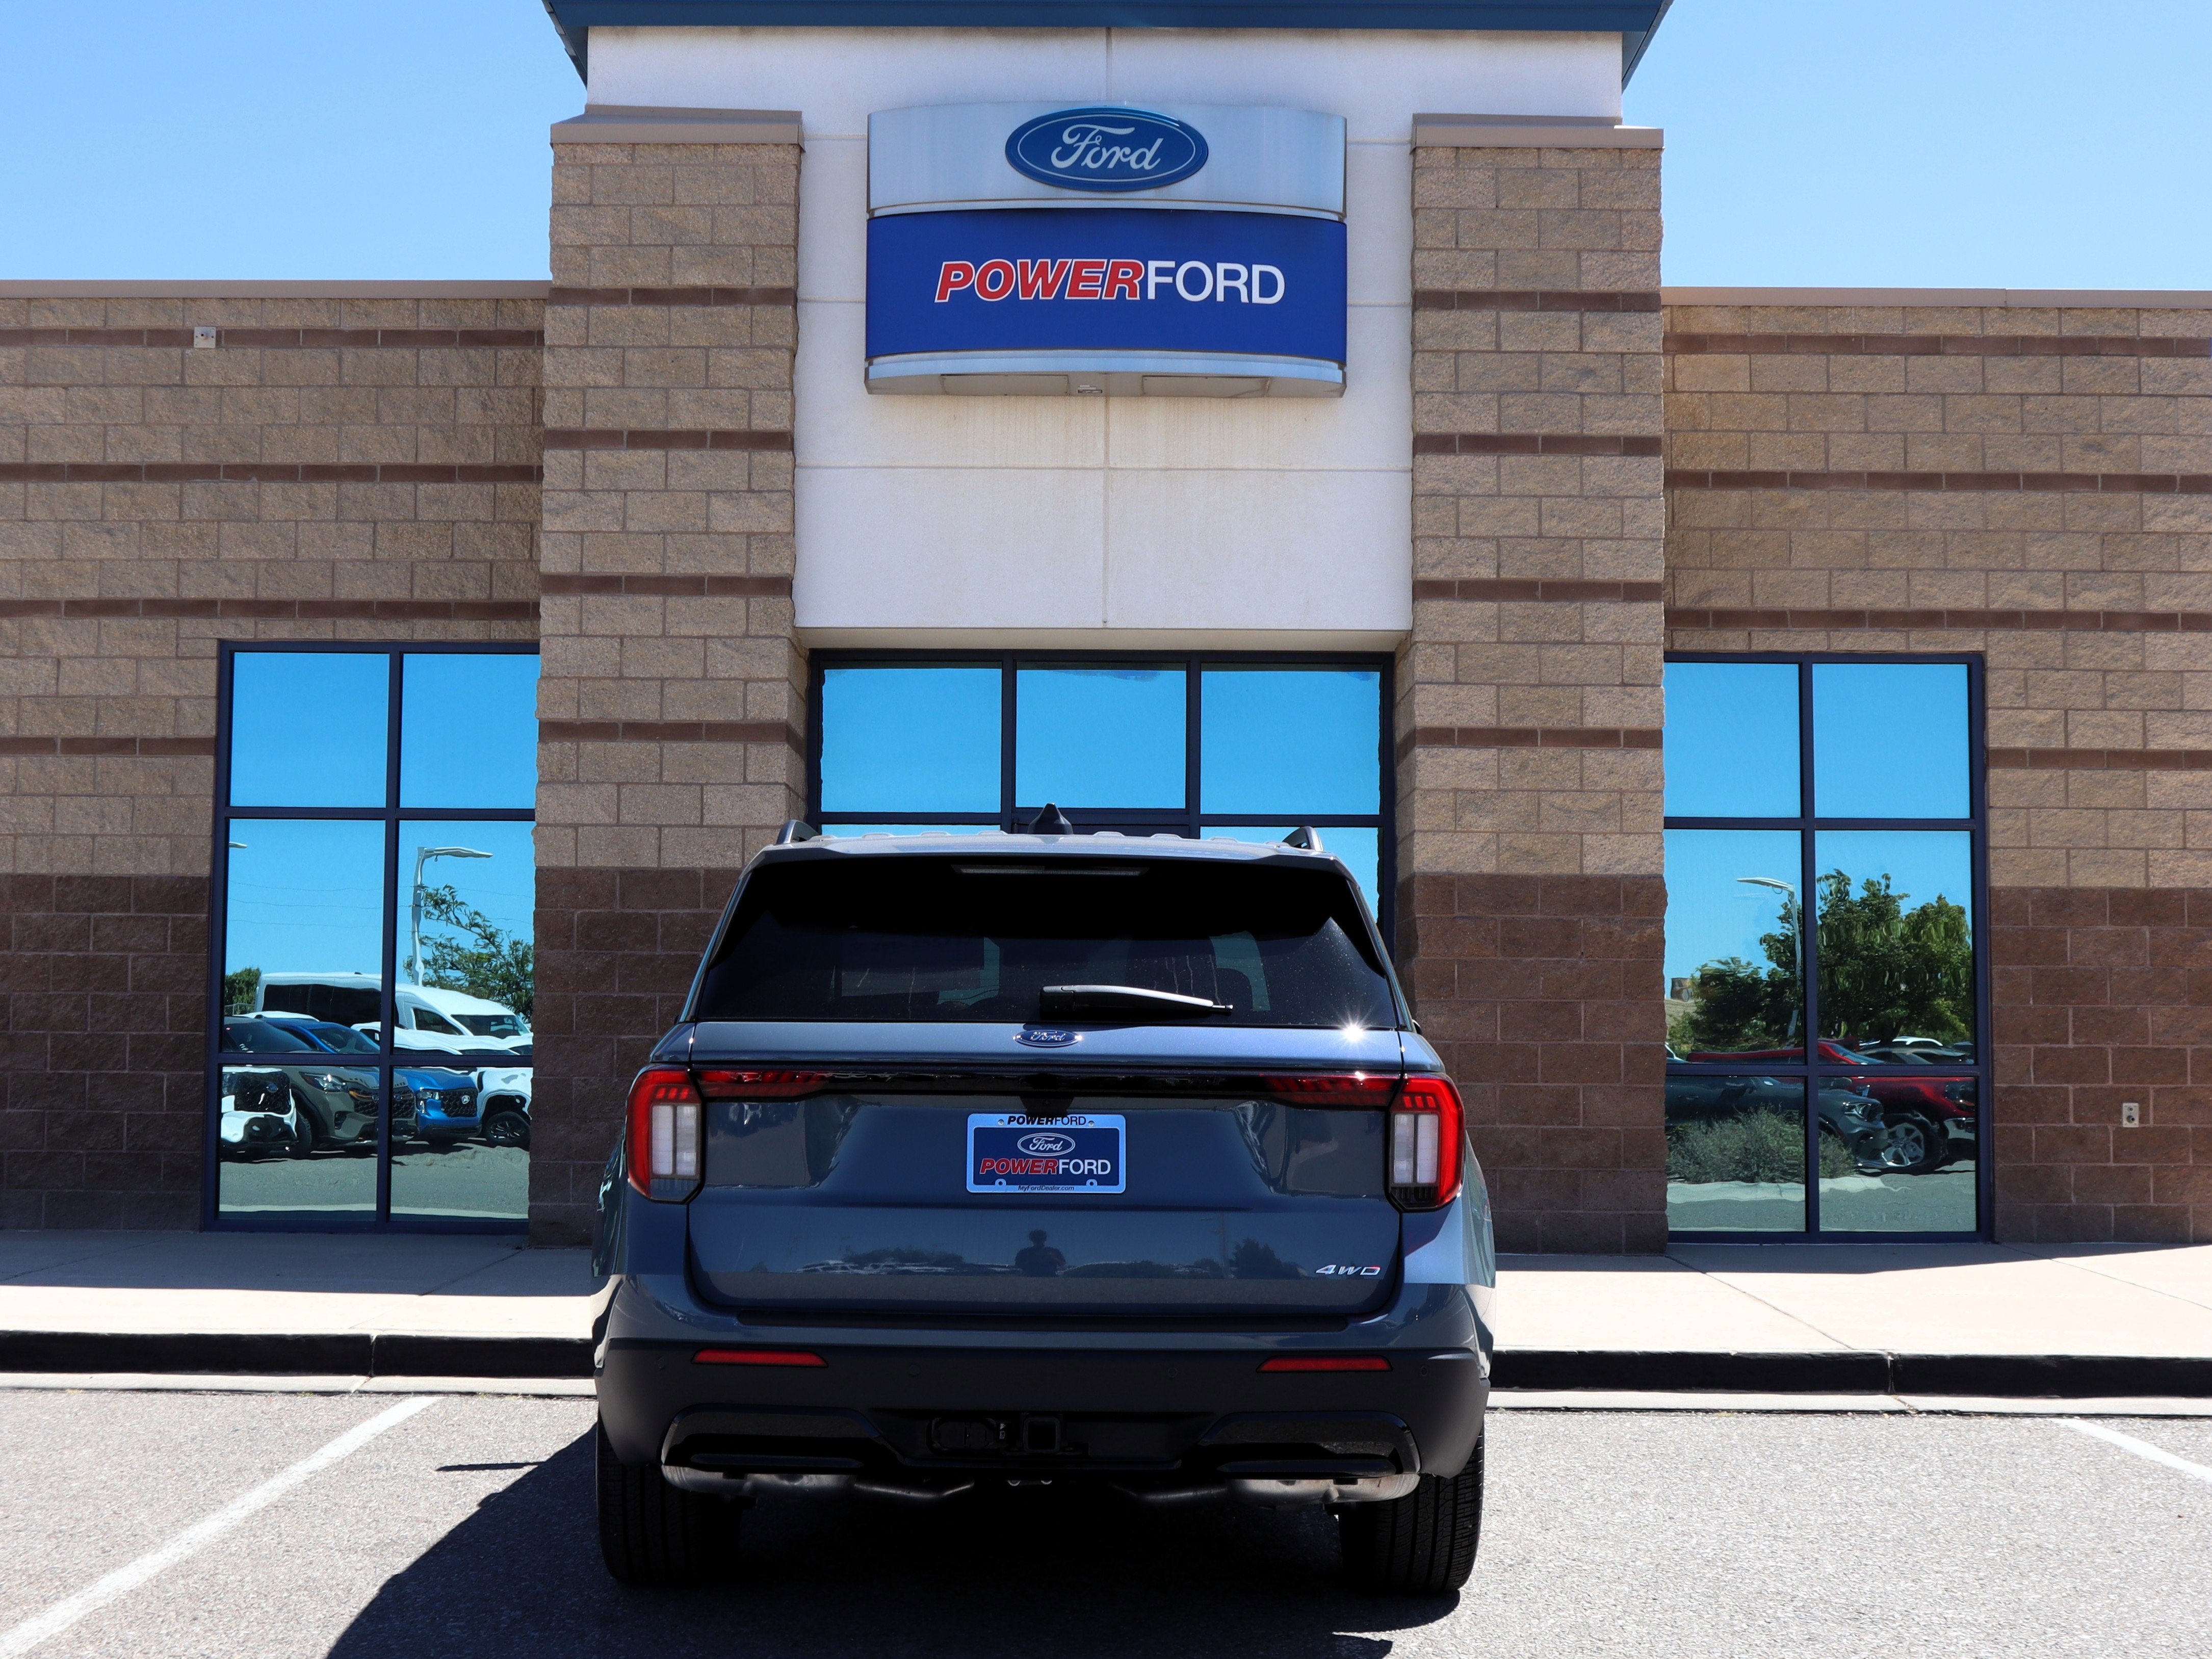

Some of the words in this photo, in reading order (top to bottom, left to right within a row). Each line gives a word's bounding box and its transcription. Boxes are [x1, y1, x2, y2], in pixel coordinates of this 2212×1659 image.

[1051, 124, 1163, 169] Ford
[1030, 1031, 1066, 1041] Ford
[1029, 1137, 1063, 1151] Ford
[1315, 1264, 1381, 1275] 4WD
